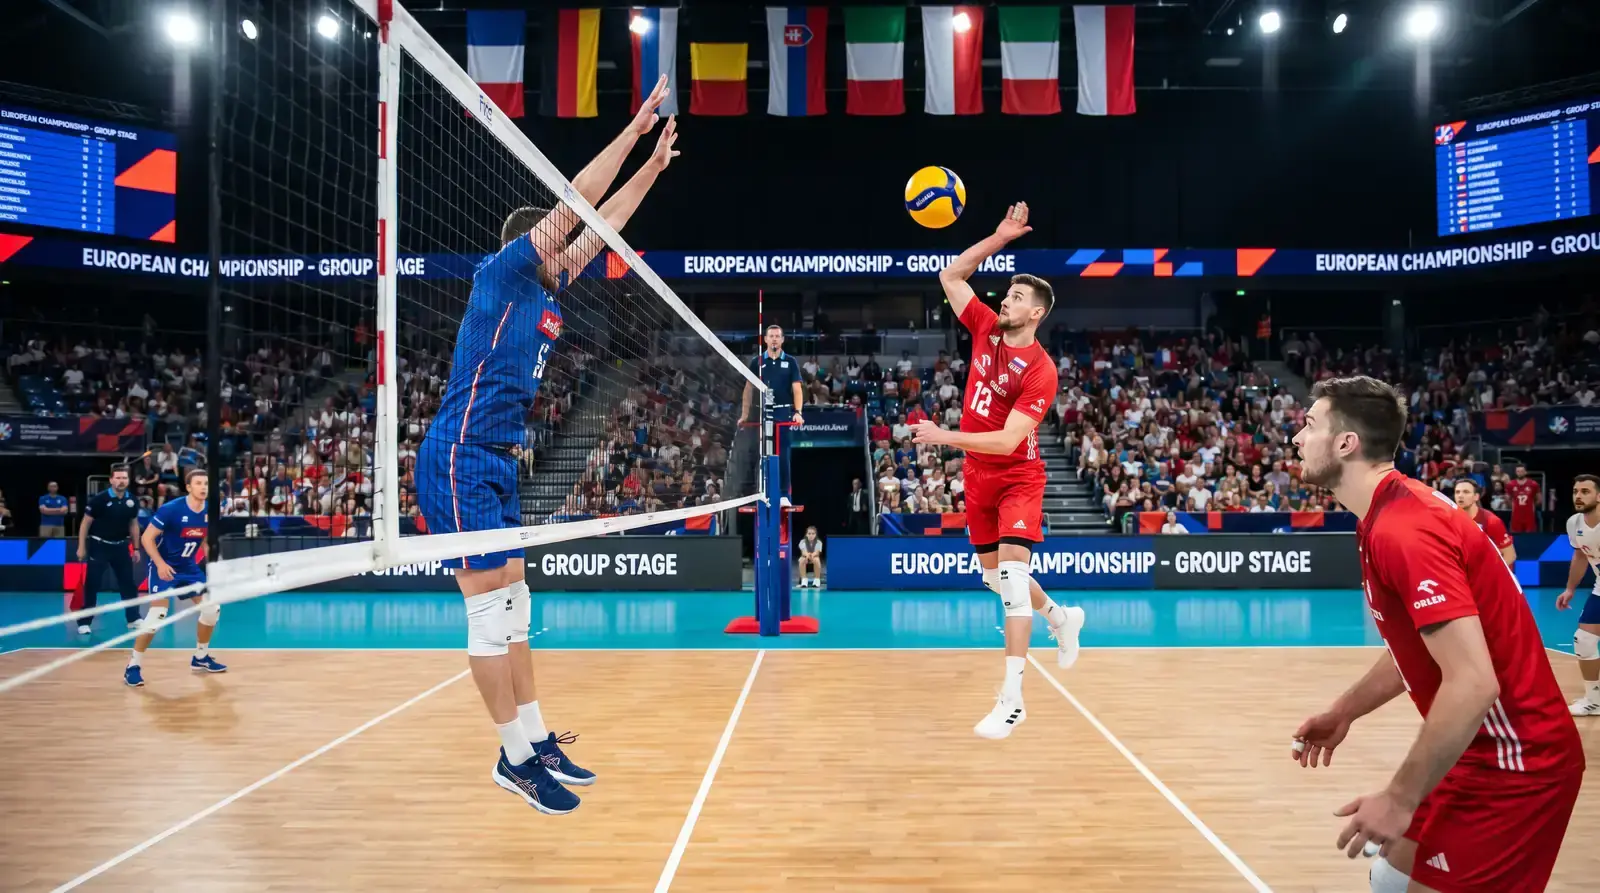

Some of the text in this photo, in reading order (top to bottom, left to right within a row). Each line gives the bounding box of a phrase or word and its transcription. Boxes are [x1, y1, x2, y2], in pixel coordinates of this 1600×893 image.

[1565, 103, 1590, 115] GROUP
[1, 109, 38, 123] EUROPEAN
[94, 126, 117, 137] GROUP
[117, 130, 138, 141] STAGE
[82, 247, 177, 275] EUROPEAN
[319, 257, 374, 277] GROUP
[395, 257, 425, 276] AGE
[684, 255, 768, 273] EUROPEAN
[770, 255, 893, 273] CHAMPIONSHIP
[978, 254, 1016, 273] AGE
[1315, 253, 1399, 272] EUROPEAN
[1401, 240, 1534, 272] CHAMPIONSHIP
[970, 380, 992, 418] 12
[180, 541, 198, 558] 17
[541, 553, 611, 576] GROUP
[614, 553, 678, 576] STAGE
[890, 552, 984, 575] EUROPEA
[1028, 551, 1156, 575] AMPIONSHIP
[1174, 551, 1245, 574] GROUP
[1248, 550, 1312, 574] STAGE
[1413, 594, 1447, 609] ORLEN
